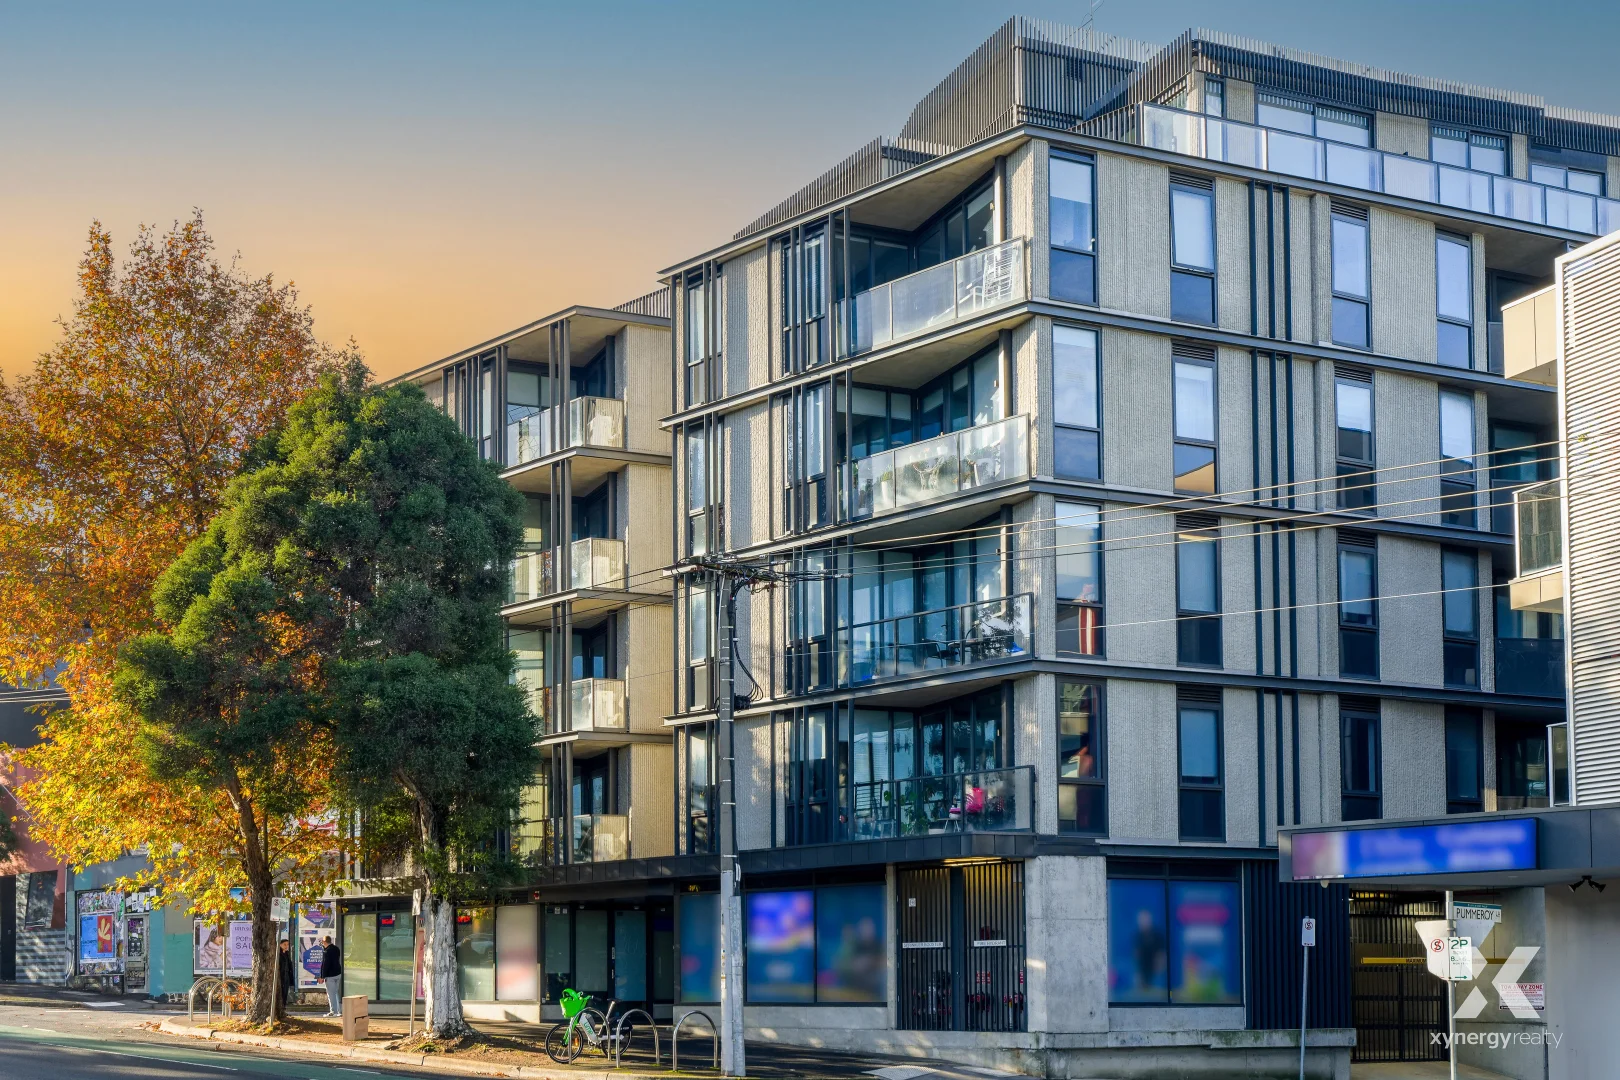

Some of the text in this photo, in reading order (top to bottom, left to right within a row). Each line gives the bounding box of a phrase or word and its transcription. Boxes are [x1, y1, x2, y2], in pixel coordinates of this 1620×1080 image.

[1456, 907, 1494, 921] PUMMEROY
[235, 942, 252, 950] SAL
[1450, 939, 1468, 950] 2P
